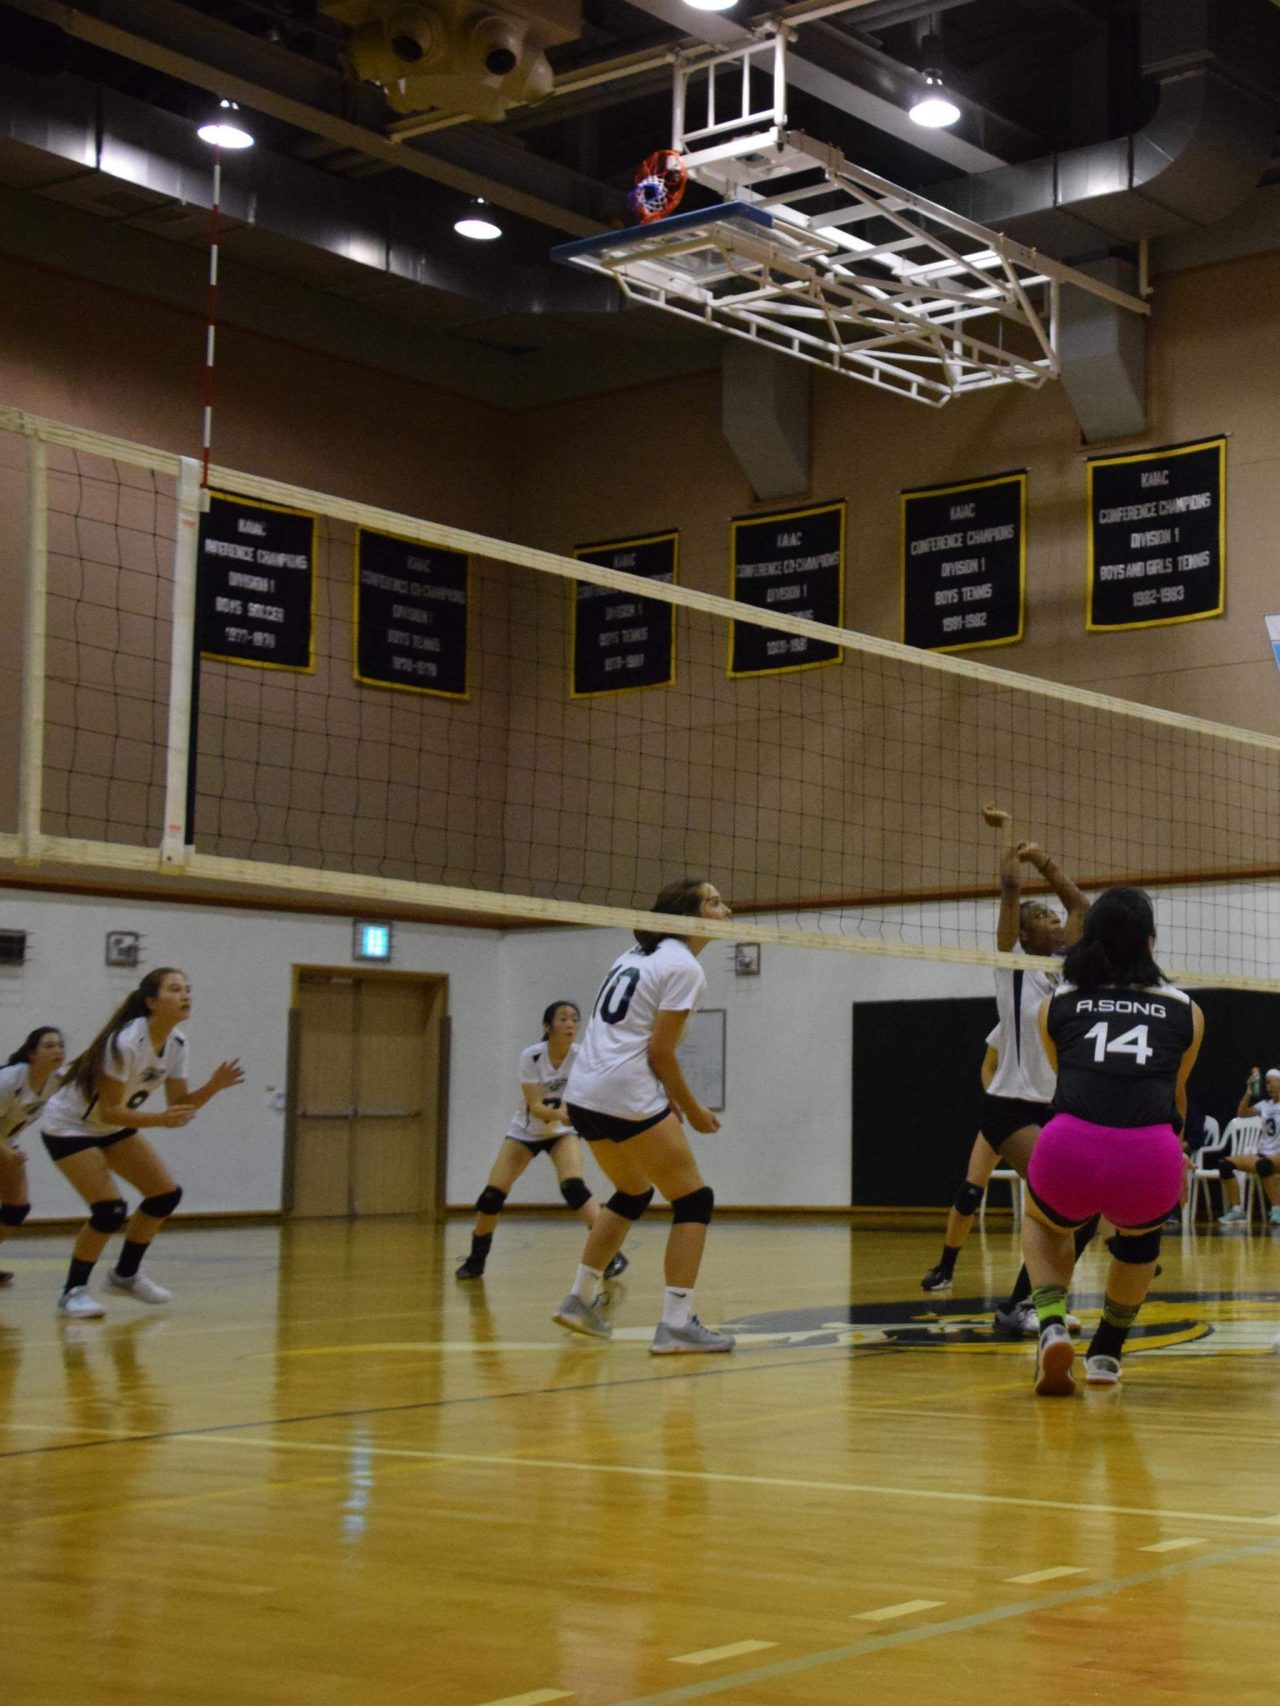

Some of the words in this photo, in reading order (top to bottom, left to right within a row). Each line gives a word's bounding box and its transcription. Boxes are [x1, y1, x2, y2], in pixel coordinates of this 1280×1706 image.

[1141, 470, 1170, 488] KAIAC
[951, 503, 976, 520] KAIAC
[1099, 501, 1158, 524] CONFERENCE
[1159, 492, 1211, 513] CHAMPIONS
[911, 532, 964, 556] CONFERENCE
[966, 524, 1014, 545] CHAMPIONS
[1130, 529, 1171, 548] DIVISION
[1175, 527, 1180, 543] 1
[941, 558, 978, 577] DIVISION
[981, 557, 985, 572] 1
[1100, 564, 1125, 581] BOYS
[1126, 562, 1145, 578] AND
[1146, 558, 1172, 576] GIRLS
[1177, 550, 1210, 571] TENNIS
[766, 585, 800, 603] DIVISION
[934, 588, 958, 606] BOYS
[961, 583, 992, 602] TENNIS
[1133, 585, 1184, 607] 1982-1983
[1076, 1000, 1166, 1018] A.SONG
[1084, 1021, 1153, 1065] 14
[1266, 1118, 1276, 1136] 3
